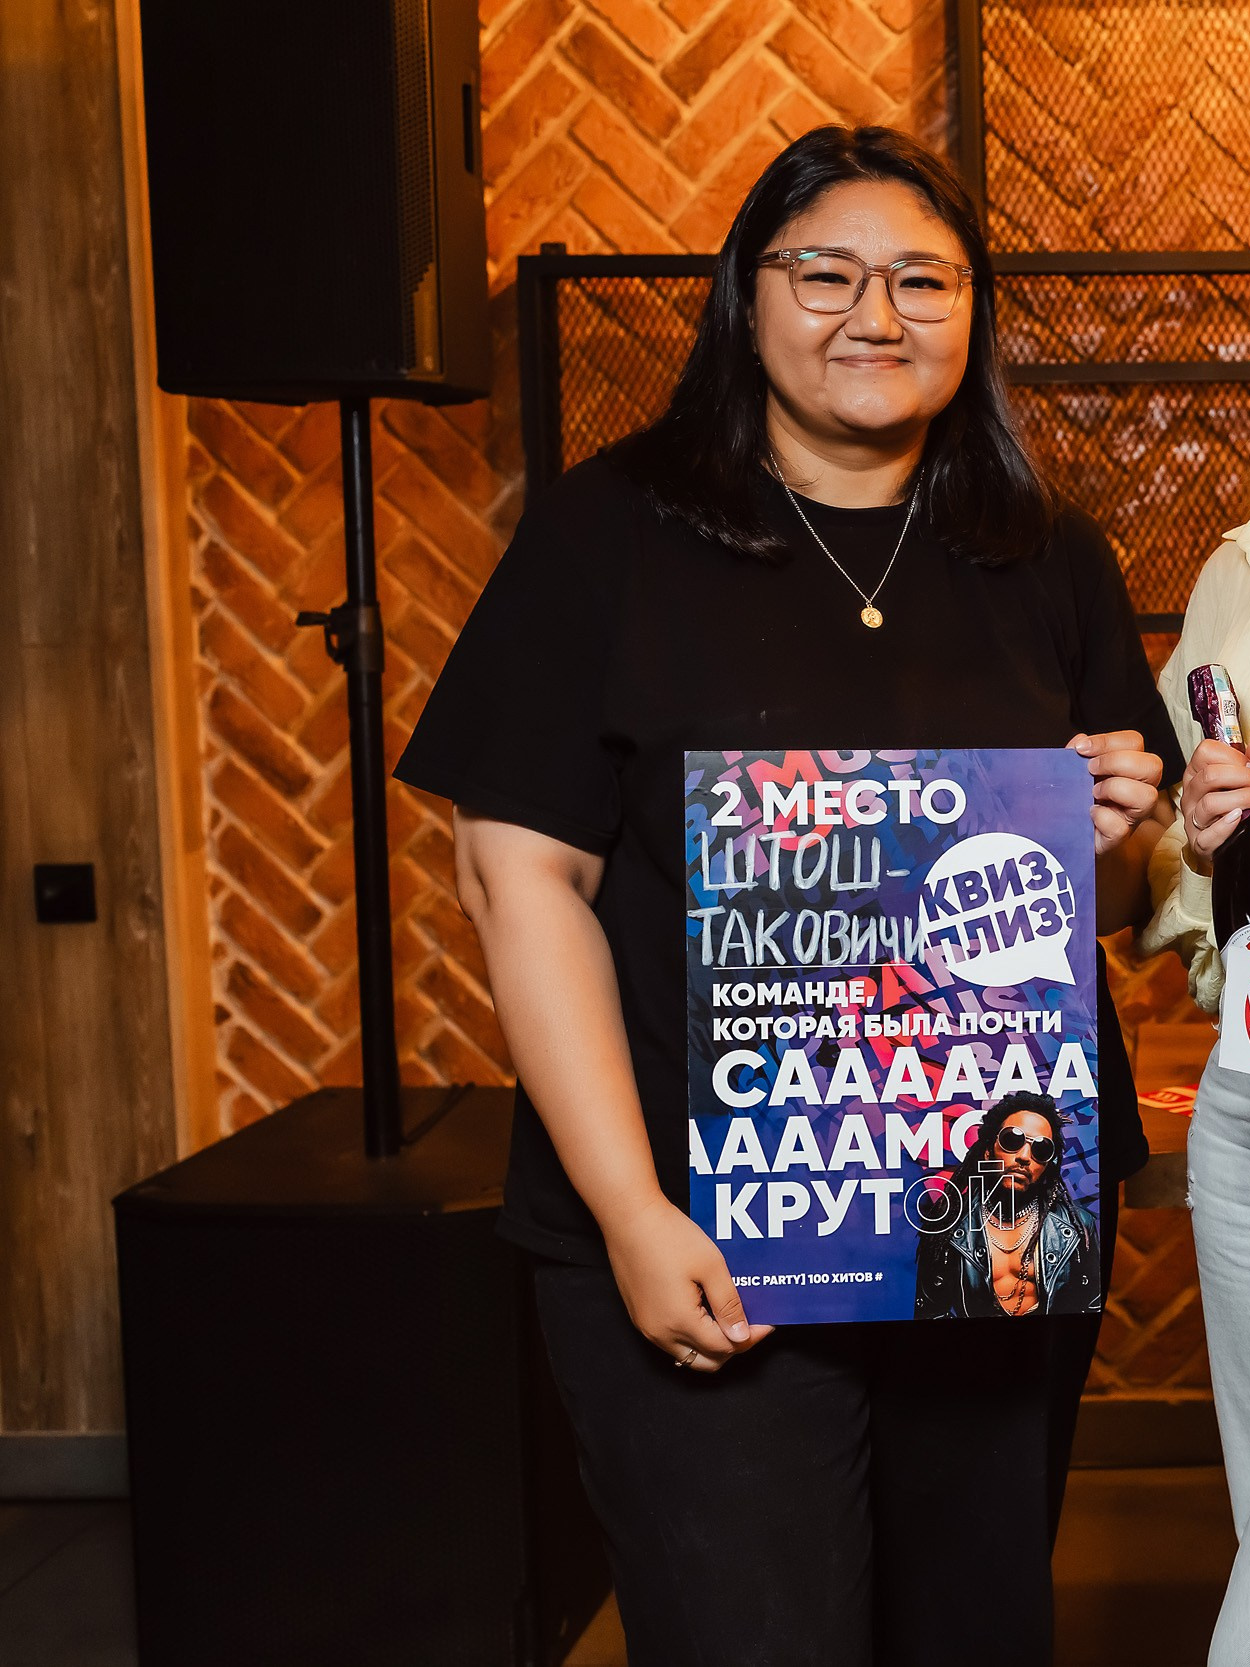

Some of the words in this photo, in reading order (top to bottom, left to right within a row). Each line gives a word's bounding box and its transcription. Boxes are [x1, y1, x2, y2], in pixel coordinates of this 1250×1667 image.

[711, 780, 743, 826] 2
[762, 778, 967, 826] МЕСТО
[924, 850, 1068, 923] КВИЗ,
[928, 892, 1076, 966] ПЛИЗ!
[713, 980, 875, 1008] КОМАНДЕ,
[713, 1015, 857, 1041] КОТОРАЯ
[864, 1012, 952, 1039] БЫЛА
[959, 1010, 1062, 1036] ПОЧТИ
[715, 1160, 1016, 1240] КРУТОЙ
[732, 1276, 761, 1287] USIC
[763, 1273, 806, 1286] PARTY]
[808, 1273, 830, 1284] 100
[832, 1272, 873, 1284] ХИТОВ
[875, 1272, 883, 1281] #
